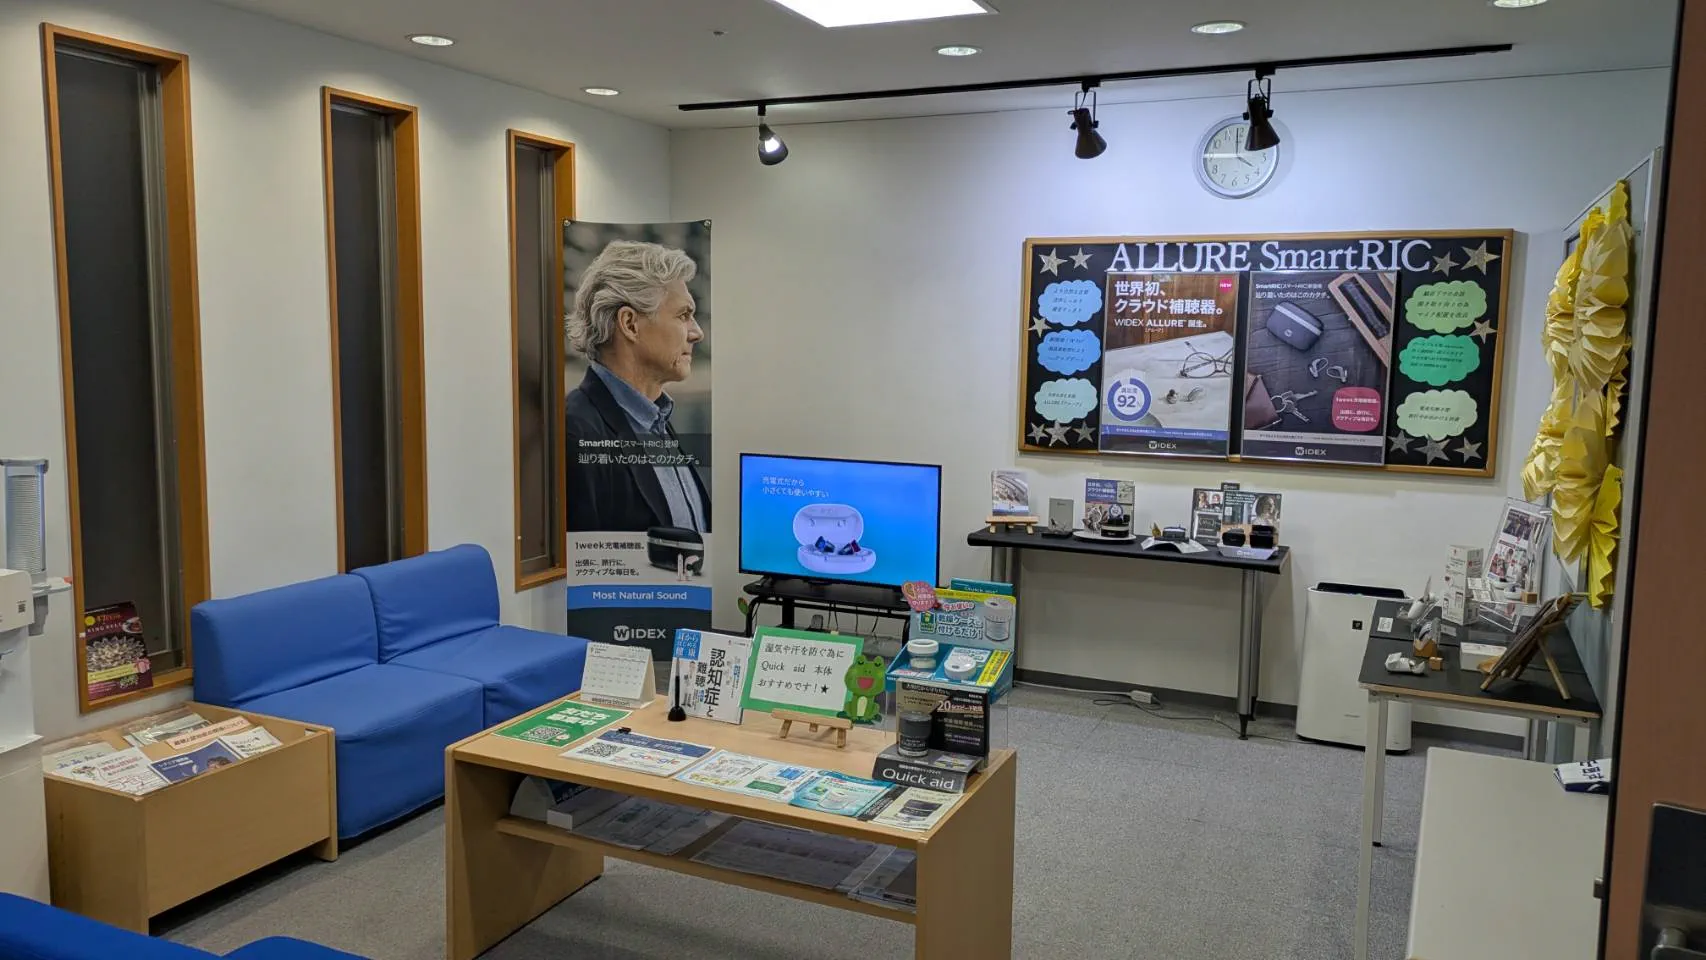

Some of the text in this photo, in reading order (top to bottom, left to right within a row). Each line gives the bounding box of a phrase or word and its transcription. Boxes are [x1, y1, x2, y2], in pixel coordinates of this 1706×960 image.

[1211, 164, 1218, 175] 8
[1254, 167, 1260, 176] 4
[1220, 173, 1226, 184] 7
[1231, 176, 1238, 187] 6
[1243, 174, 1250, 185] 5
[1104, 239, 1433, 273] ALLURE SmartRIC
[1114, 281, 1166, 297] 世界初、
[1114, 298, 1223, 315] クラウド補聴器。
[1114, 319, 1144, 328] WIDEX
[1148, 440, 1177, 450] WIDEX
[1294, 446, 1327, 456] WIDEX
[578, 453, 700, 465] 辿り着いたのはこのカタチ。
[762, 476, 805, 487] 充電式だから
[762, 486, 830, 499] 小さくても使いやすい
[575, 541, 645, 551] 1week充電補聴器。
[575, 568, 640, 577] アクティブな毎日を。
[592, 591, 688, 601] Most Natural Sound
[613, 625, 667, 642] WIDEX
[764, 643, 845, 658] 湿気や汗を防ぐ為に
[761, 660, 833, 675] Quick aid 本体
[704, 648, 726, 718] 認知症と
[882, 767, 926, 785] Quick
[929, 777, 955, 790] aid
